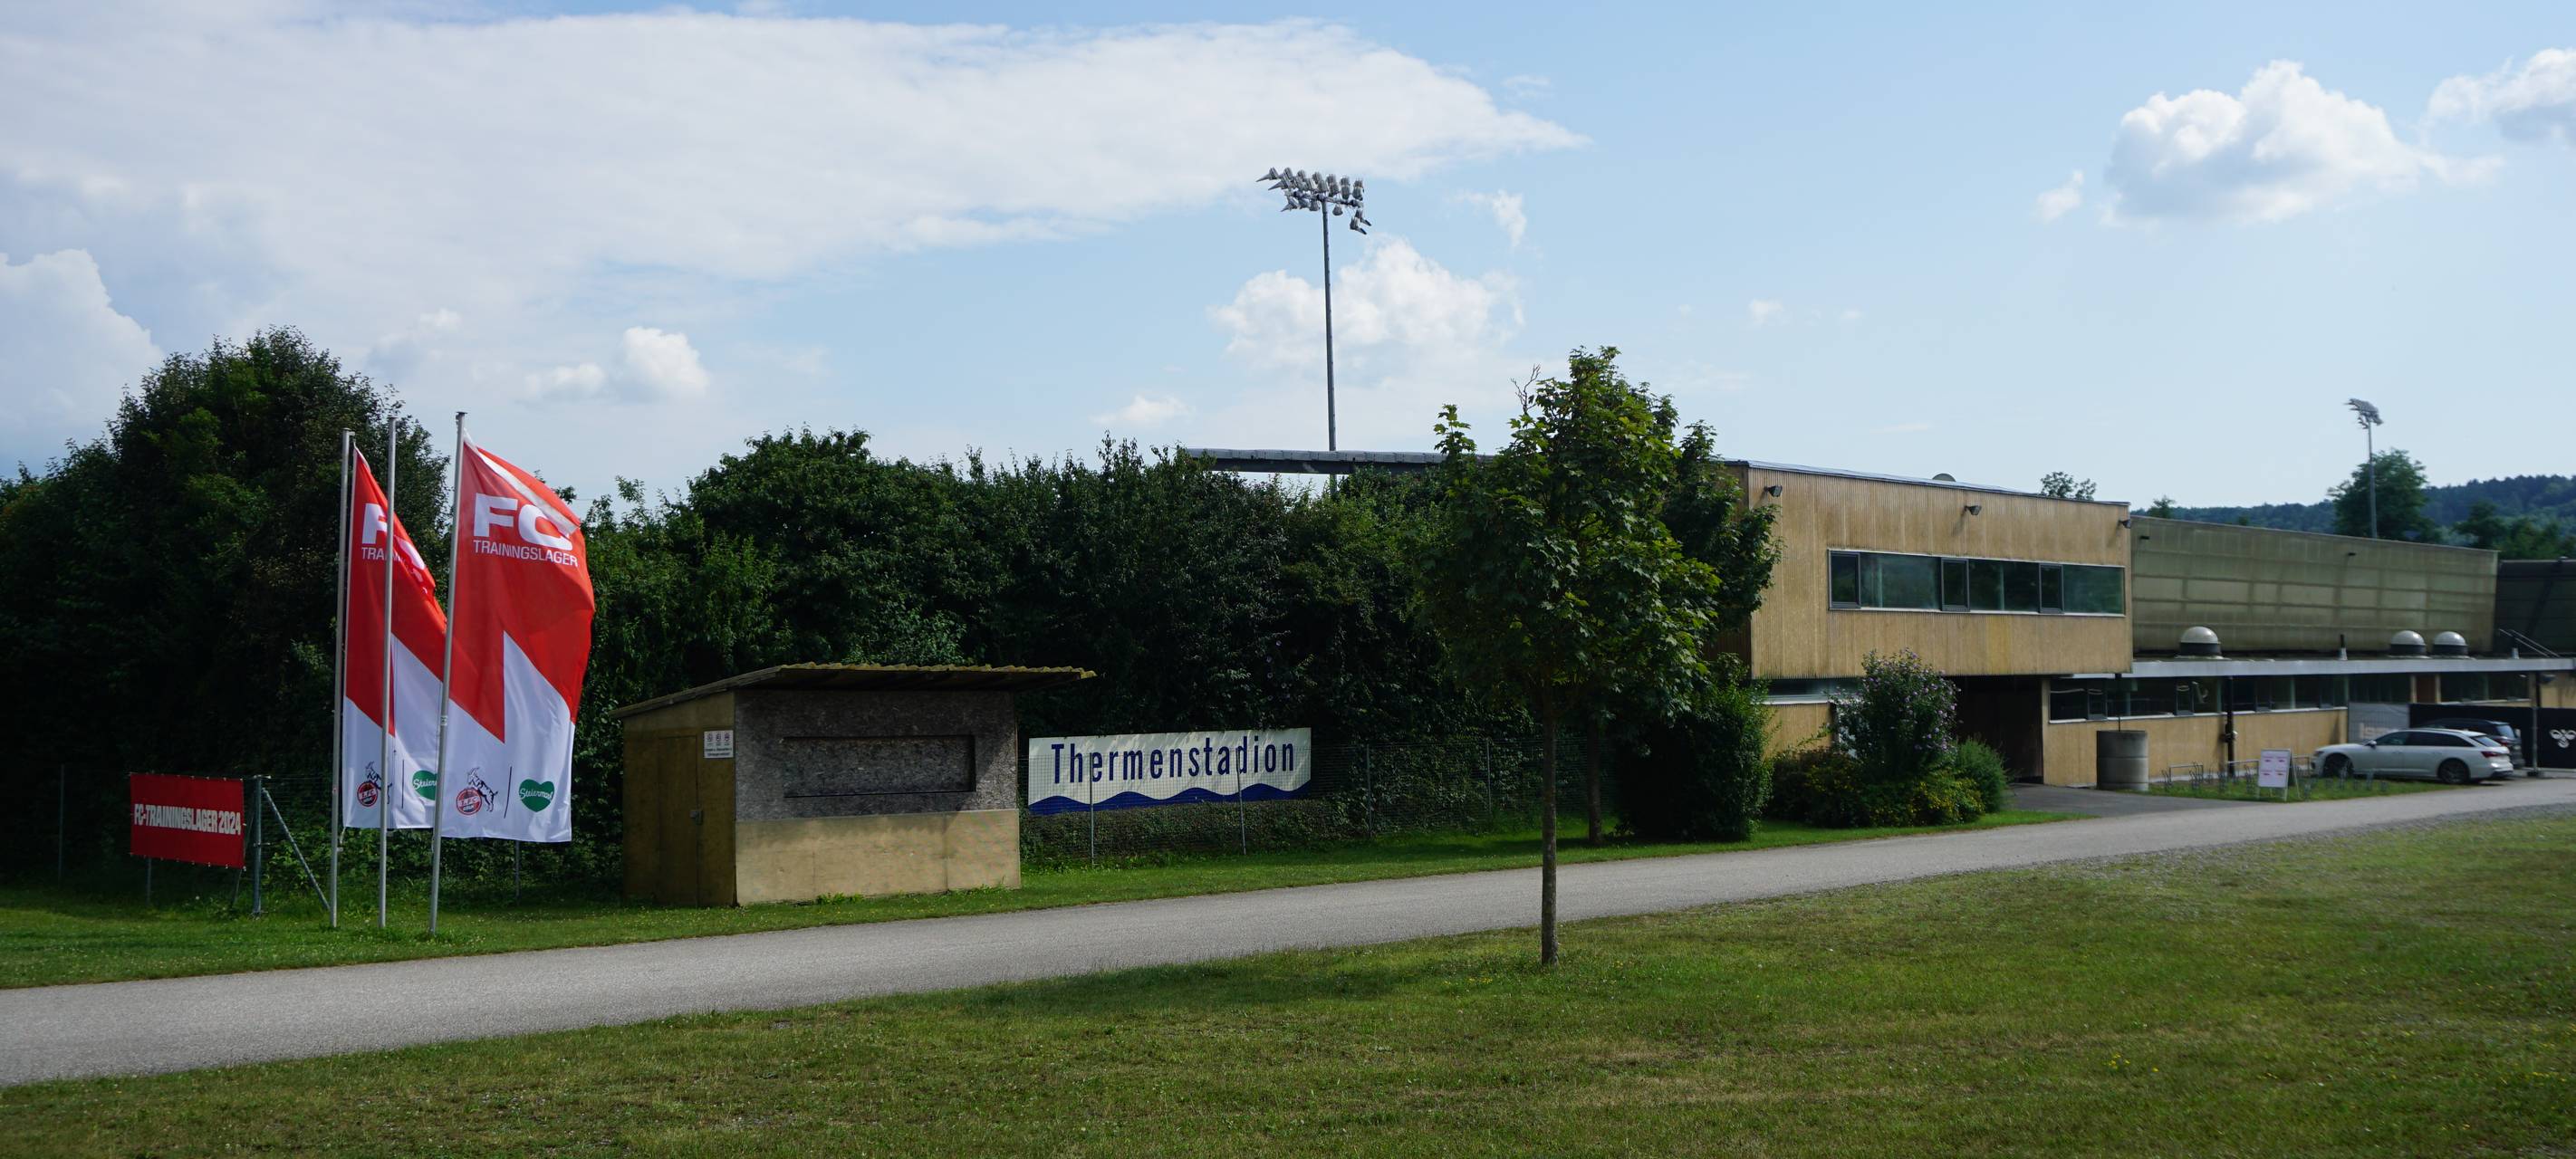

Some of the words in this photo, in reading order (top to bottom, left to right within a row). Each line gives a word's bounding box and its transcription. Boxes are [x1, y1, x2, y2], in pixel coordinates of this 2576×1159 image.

[473, 493, 572, 551] FC
[473, 540, 579, 567] TRAININGSLAGER
[1051, 735, 1294, 784] Thermenstadion
[134, 804, 217, 833] FC-TRAININGSLAGER
[218, 810, 241, 835] 2024
